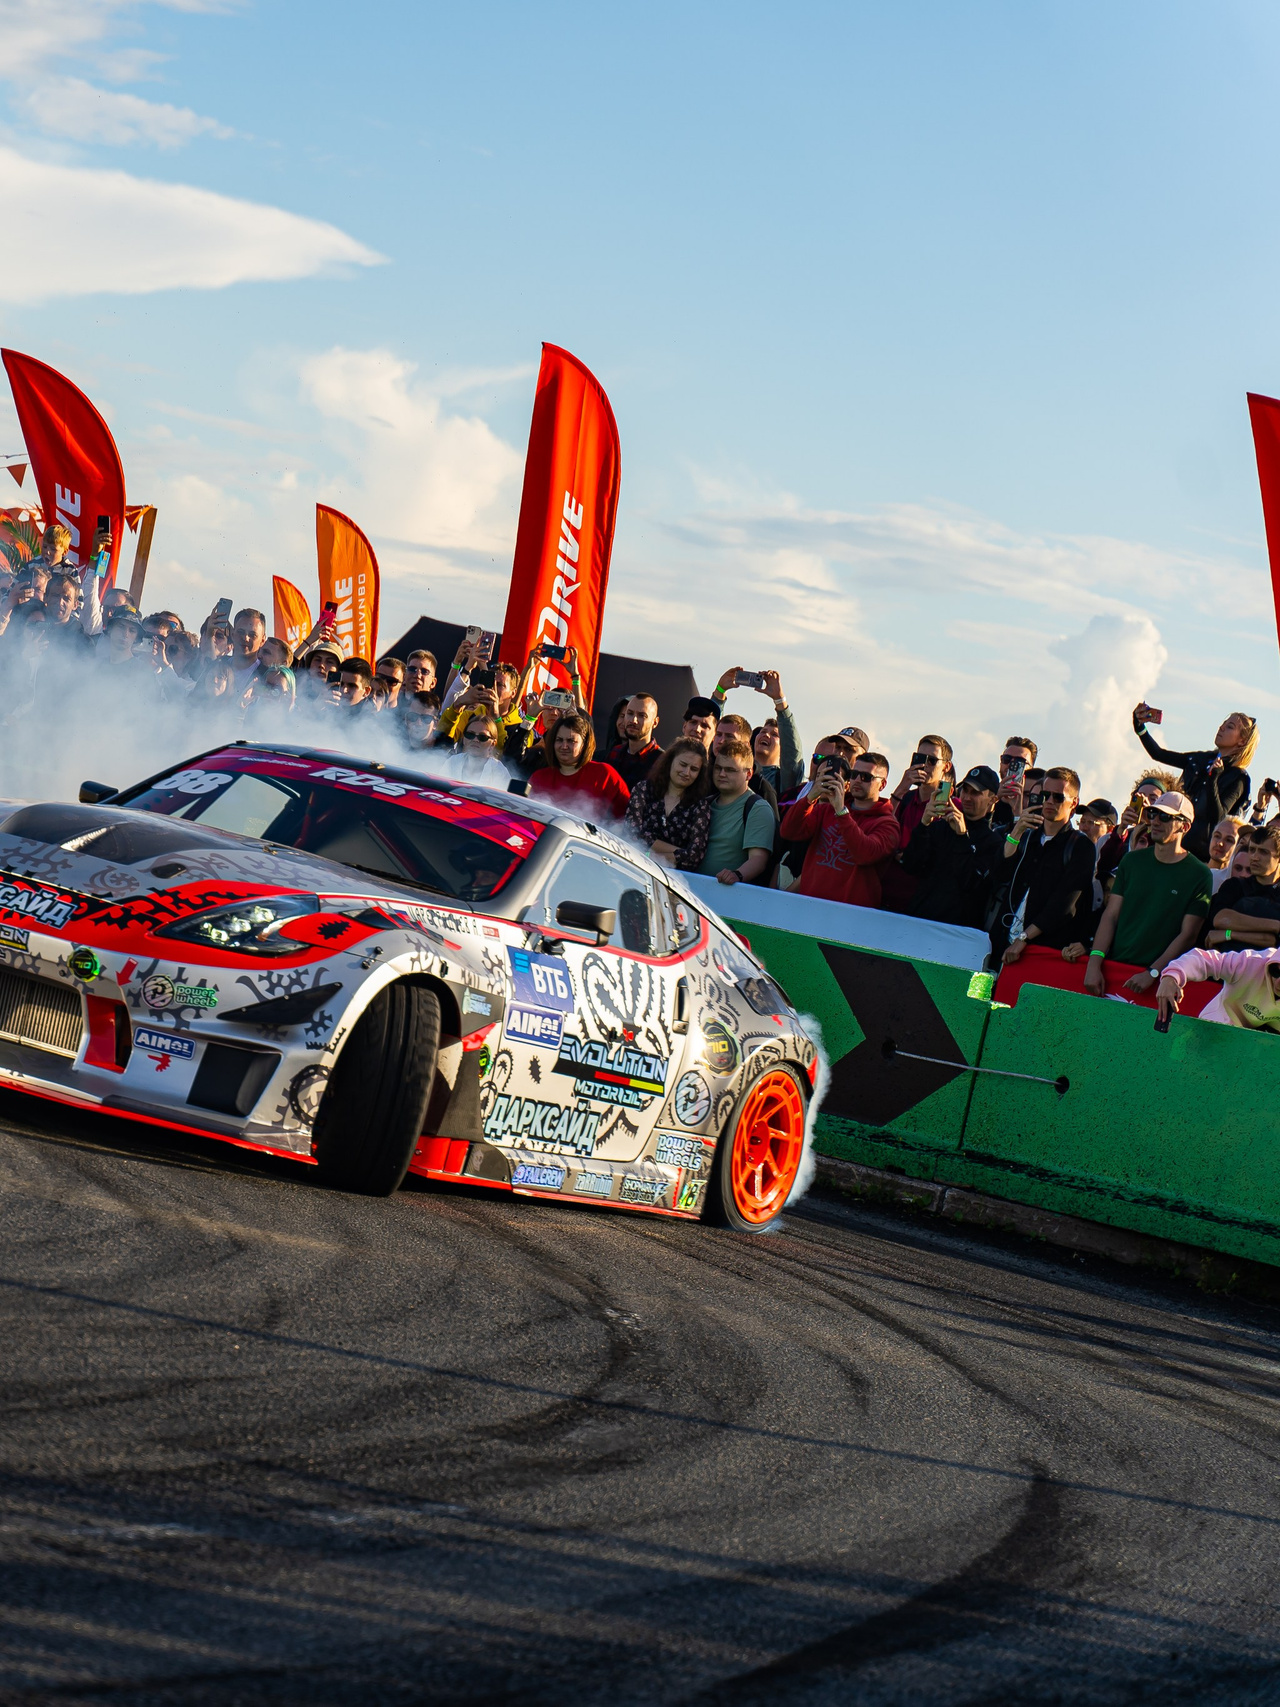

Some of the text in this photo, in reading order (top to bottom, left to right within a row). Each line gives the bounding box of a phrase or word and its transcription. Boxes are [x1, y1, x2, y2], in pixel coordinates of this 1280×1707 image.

[55, 483, 81, 568] IVE
[151, 769, 234, 794] 88
[308, 766, 463, 807] RDS GP
[176, 985, 215, 998] power
[530, 962, 569, 999] ВТБ
[176, 995, 218, 1008] wheels
[507, 1009, 561, 1042] AIMOL
[136, 1031, 192, 1055] AIMOL
[560, 1036, 669, 1082] EVOLUTION
[485, 1095, 602, 1156] ДАРКСАЙД
[657, 1134, 703, 1152] power
[655, 1149, 702, 1170] wheels
